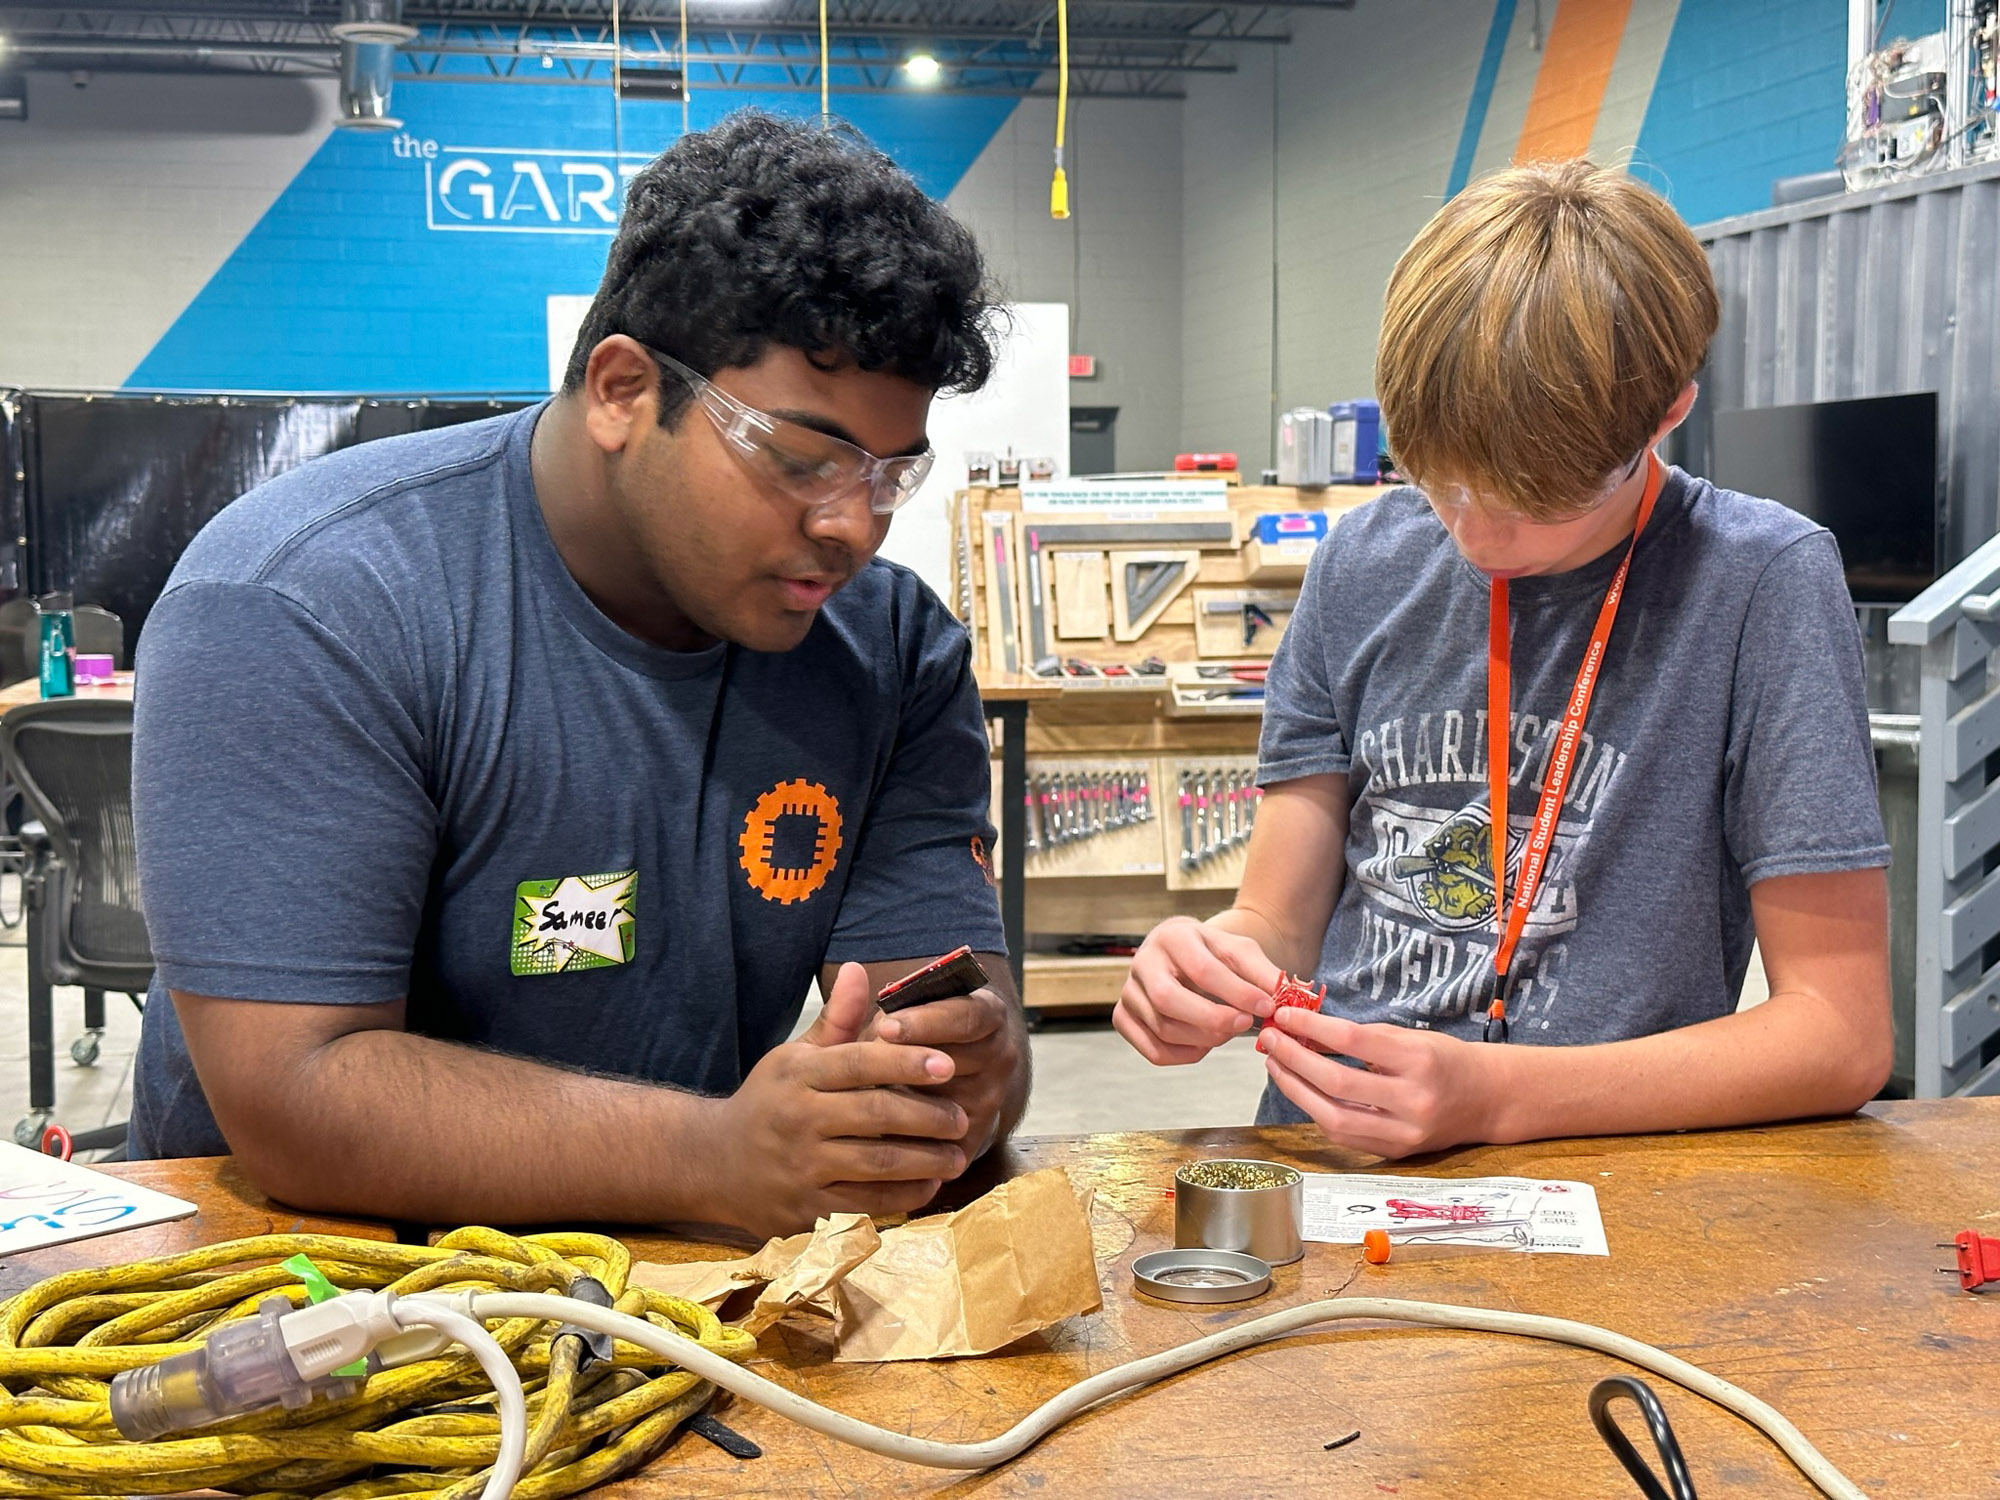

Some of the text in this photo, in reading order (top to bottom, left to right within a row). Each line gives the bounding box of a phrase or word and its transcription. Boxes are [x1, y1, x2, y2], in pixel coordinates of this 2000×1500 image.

[392, 132, 439, 159] the
[439, 159, 648, 222] GAR
[1360, 709, 1628, 816] CHARLSTON
[1517, 640, 1602, 909] National Student Leadership Conference
[538, 900, 622, 932] Sameer
